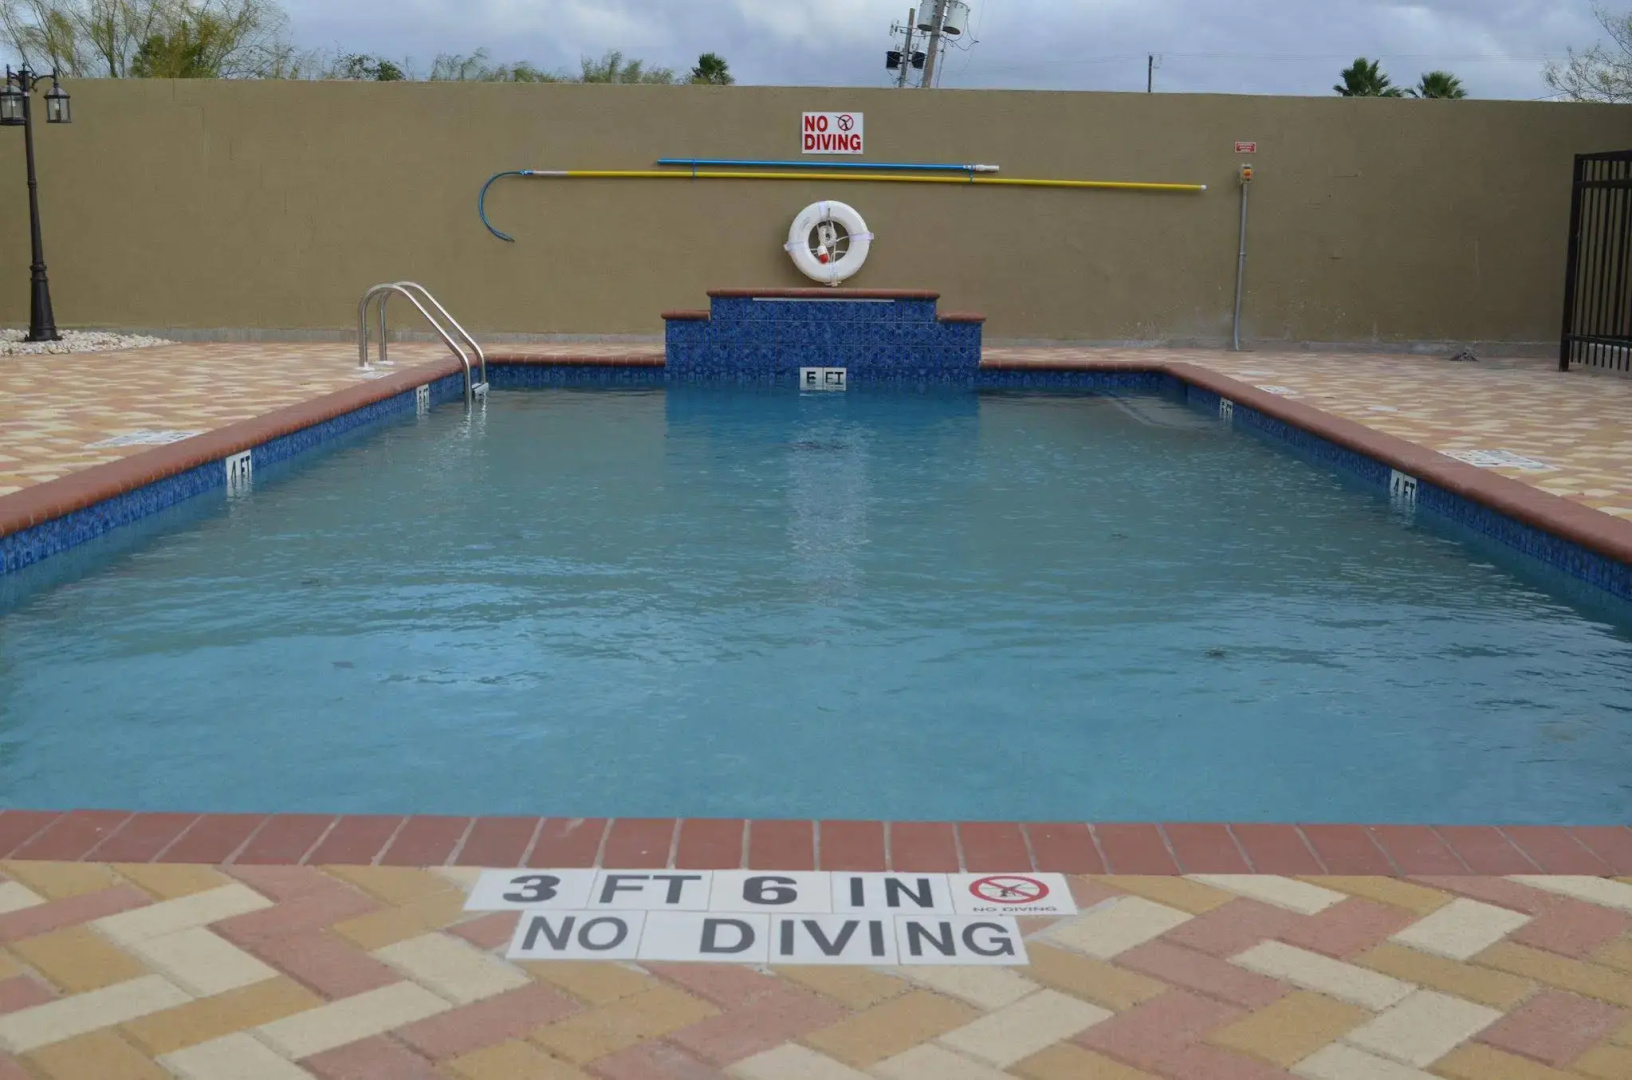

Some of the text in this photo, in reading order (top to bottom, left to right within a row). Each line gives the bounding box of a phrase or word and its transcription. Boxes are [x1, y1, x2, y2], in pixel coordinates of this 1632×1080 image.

[804, 115, 828, 132] NO
[804, 133, 861, 151] DIVING
[502, 874, 934, 908] 3 FT 6 IN
[520, 915, 1016, 957] NO DIVING
